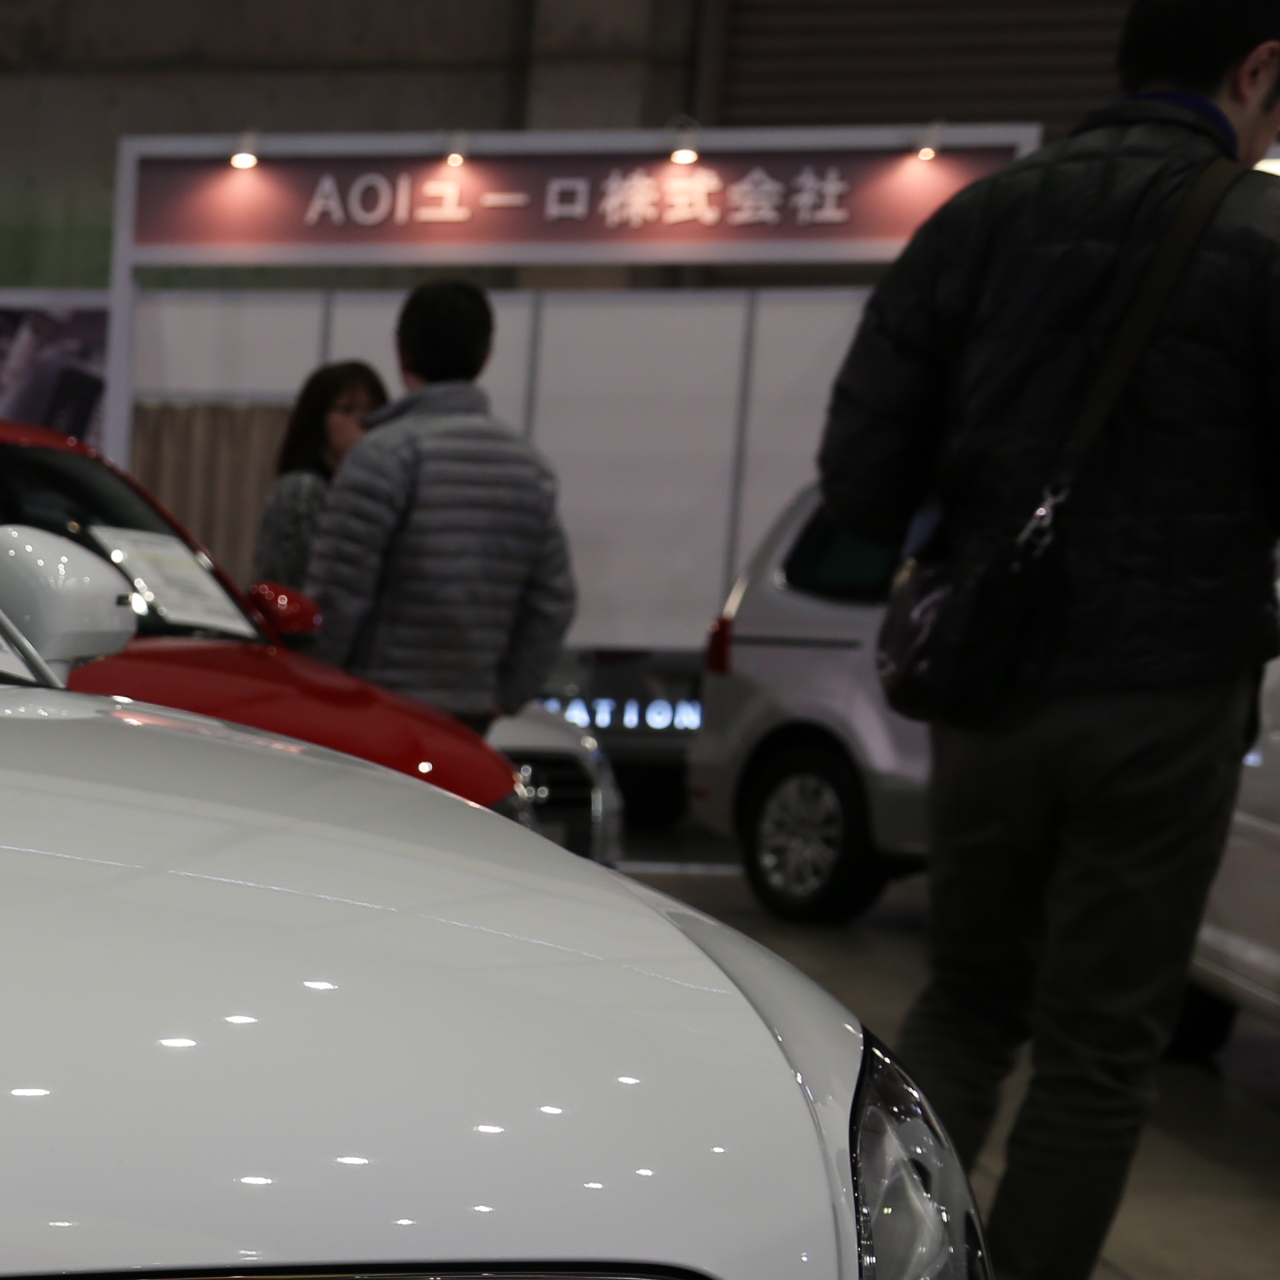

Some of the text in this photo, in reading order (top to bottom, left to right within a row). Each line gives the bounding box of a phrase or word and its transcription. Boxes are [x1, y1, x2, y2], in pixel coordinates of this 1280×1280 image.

[304, 166, 851, 227] AOIユーロ株式会社
